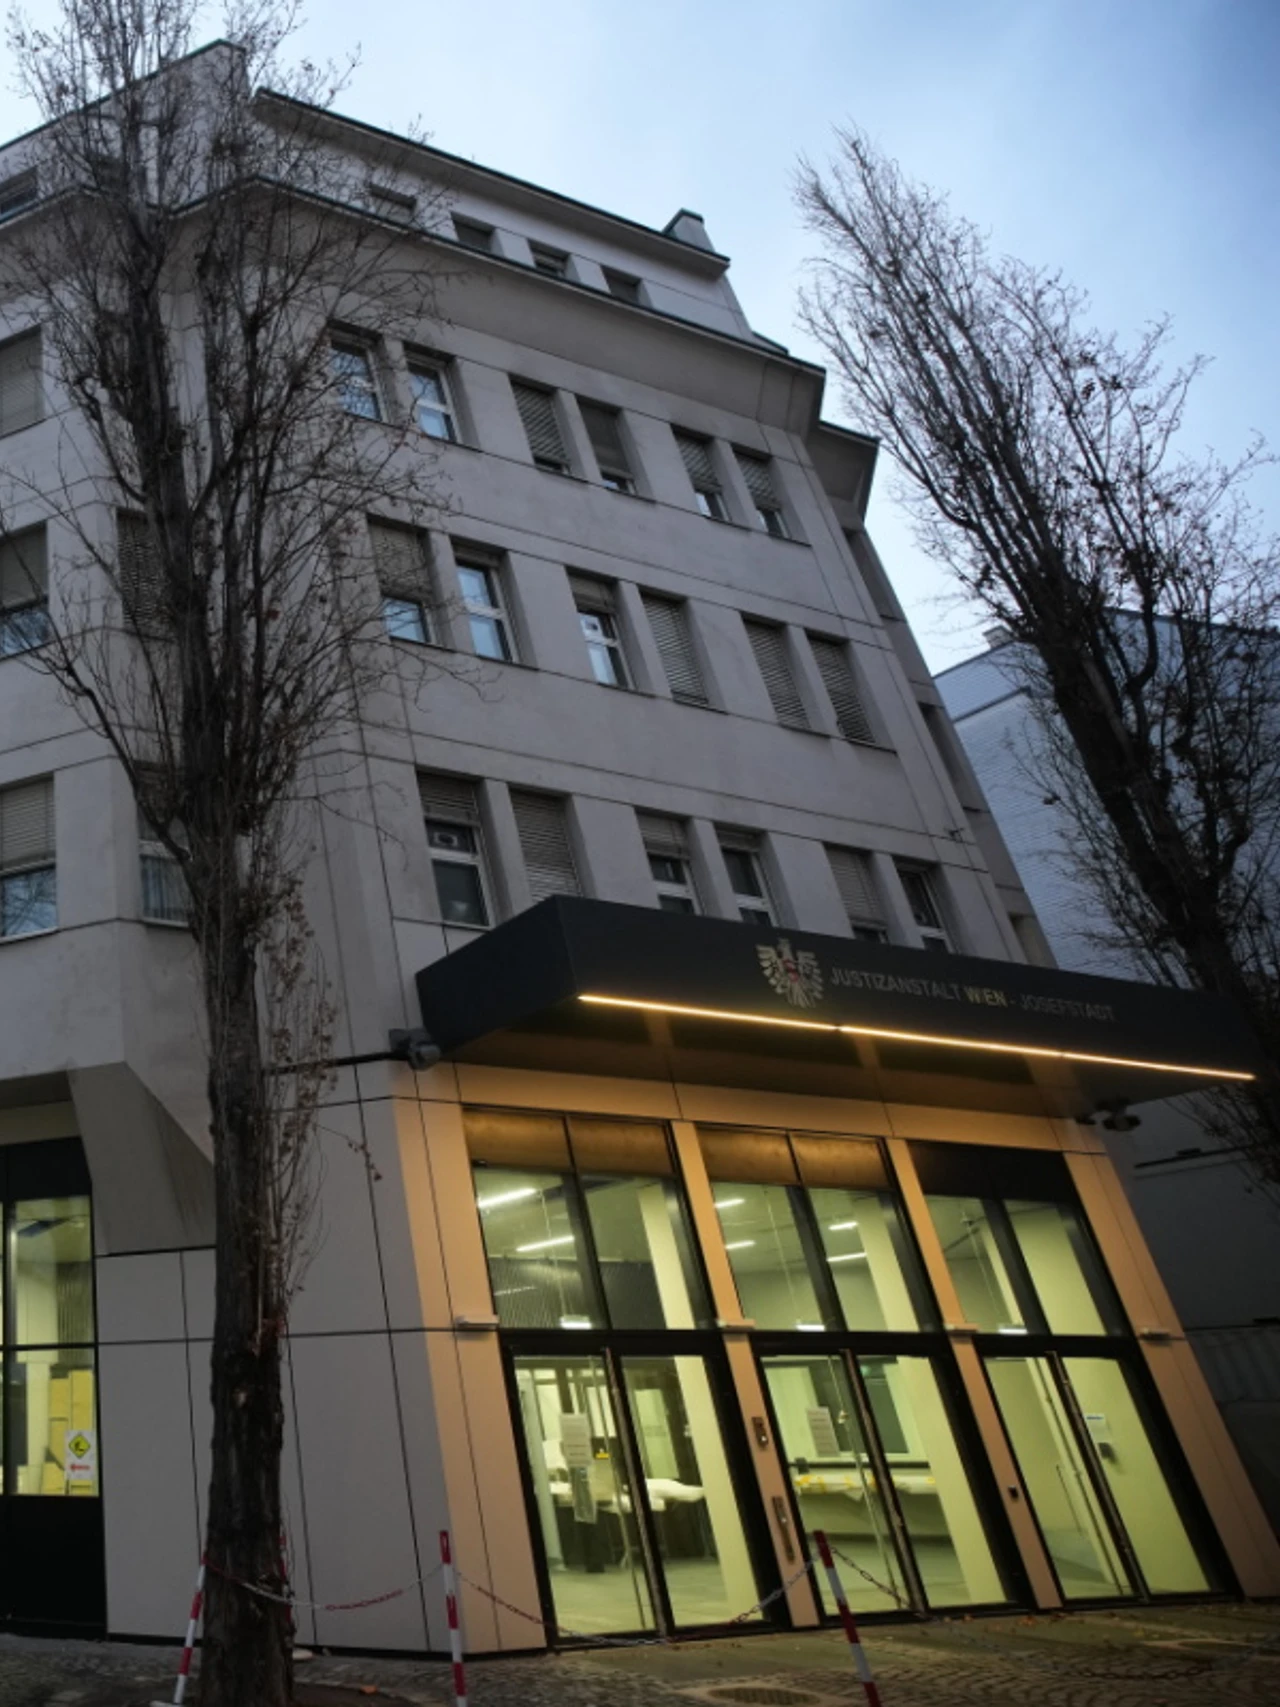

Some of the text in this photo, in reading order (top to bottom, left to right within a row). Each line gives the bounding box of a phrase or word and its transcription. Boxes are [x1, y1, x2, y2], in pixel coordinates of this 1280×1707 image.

[831, 967, 961, 1001] JUSTIZANSTALT
[963, 985, 1008, 1008] WIEN
[1019, 993, 1115, 1021] JOSEFSTADT
